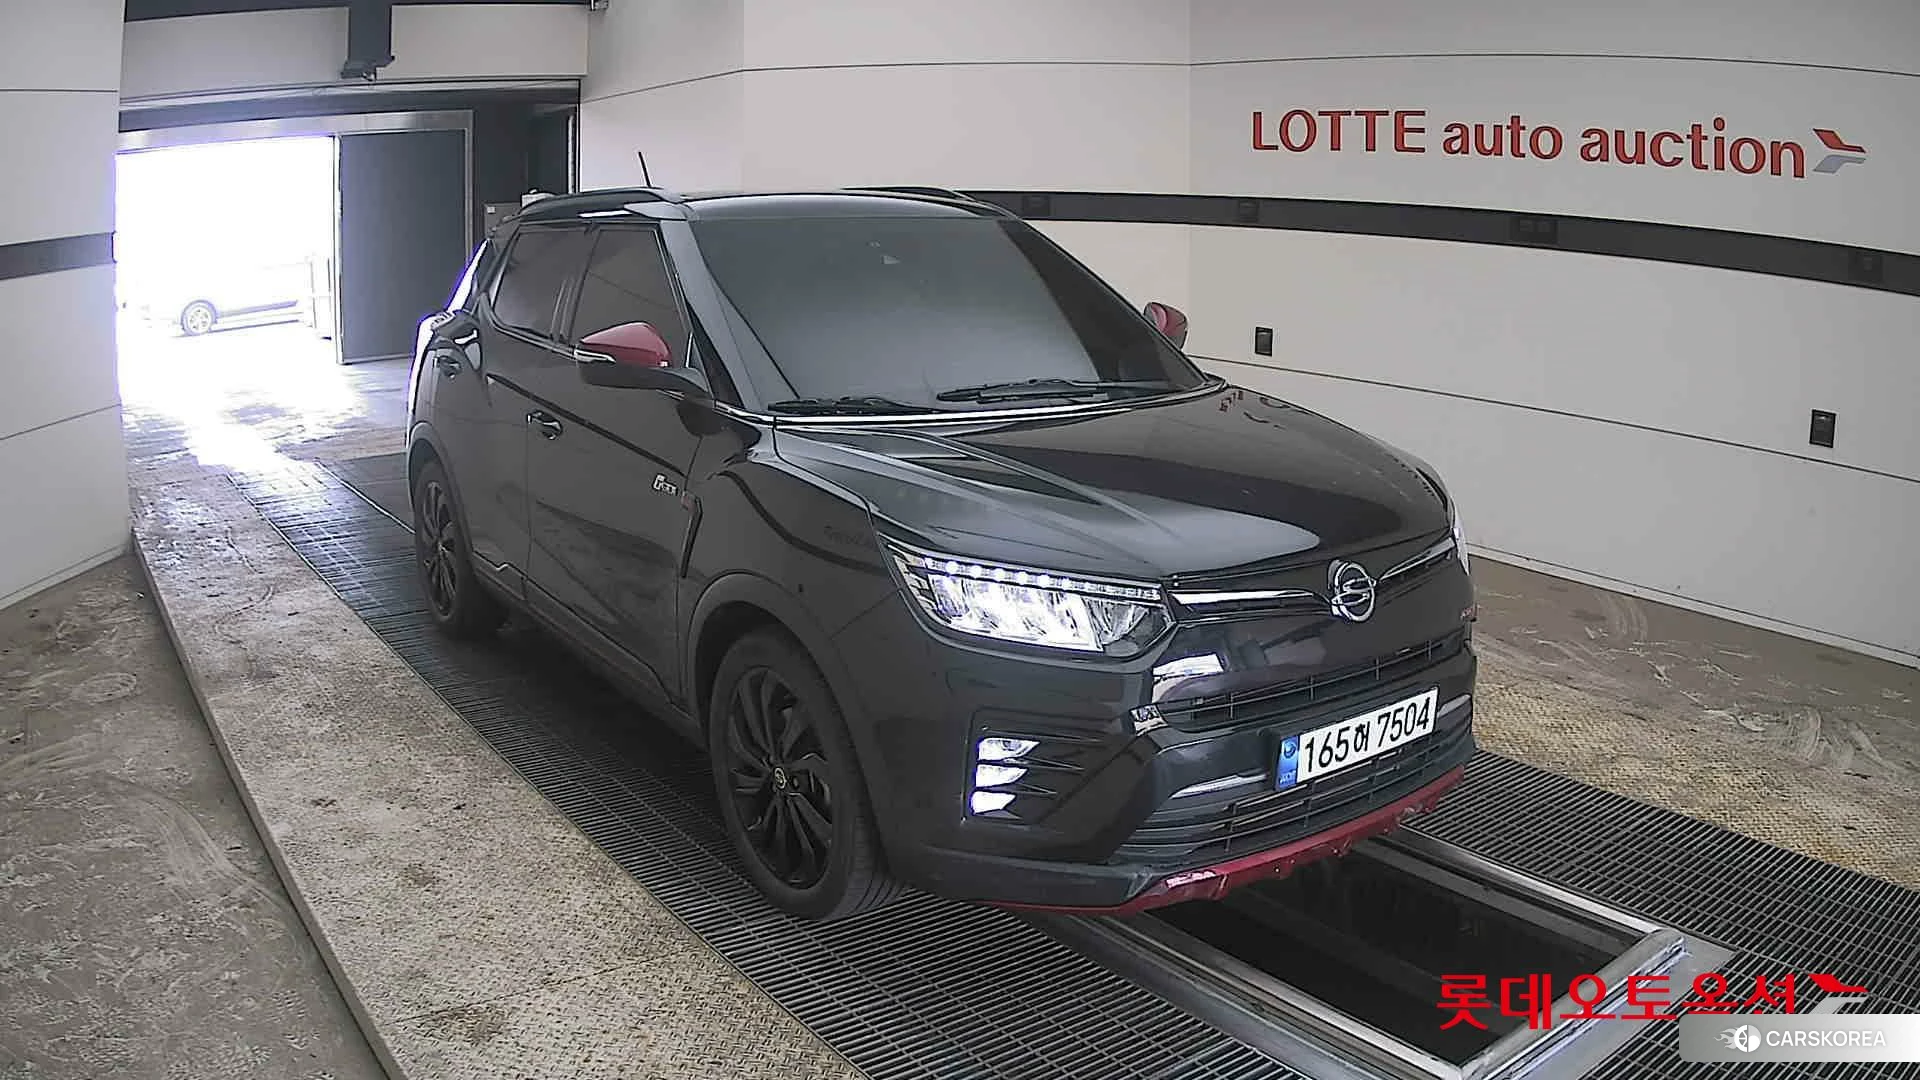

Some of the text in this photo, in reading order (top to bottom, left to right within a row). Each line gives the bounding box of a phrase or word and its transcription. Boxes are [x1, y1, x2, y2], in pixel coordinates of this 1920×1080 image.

[1252, 110, 1805, 179] LOTTE auto auction
[1305, 697, 1432, 773] 165허 7504
